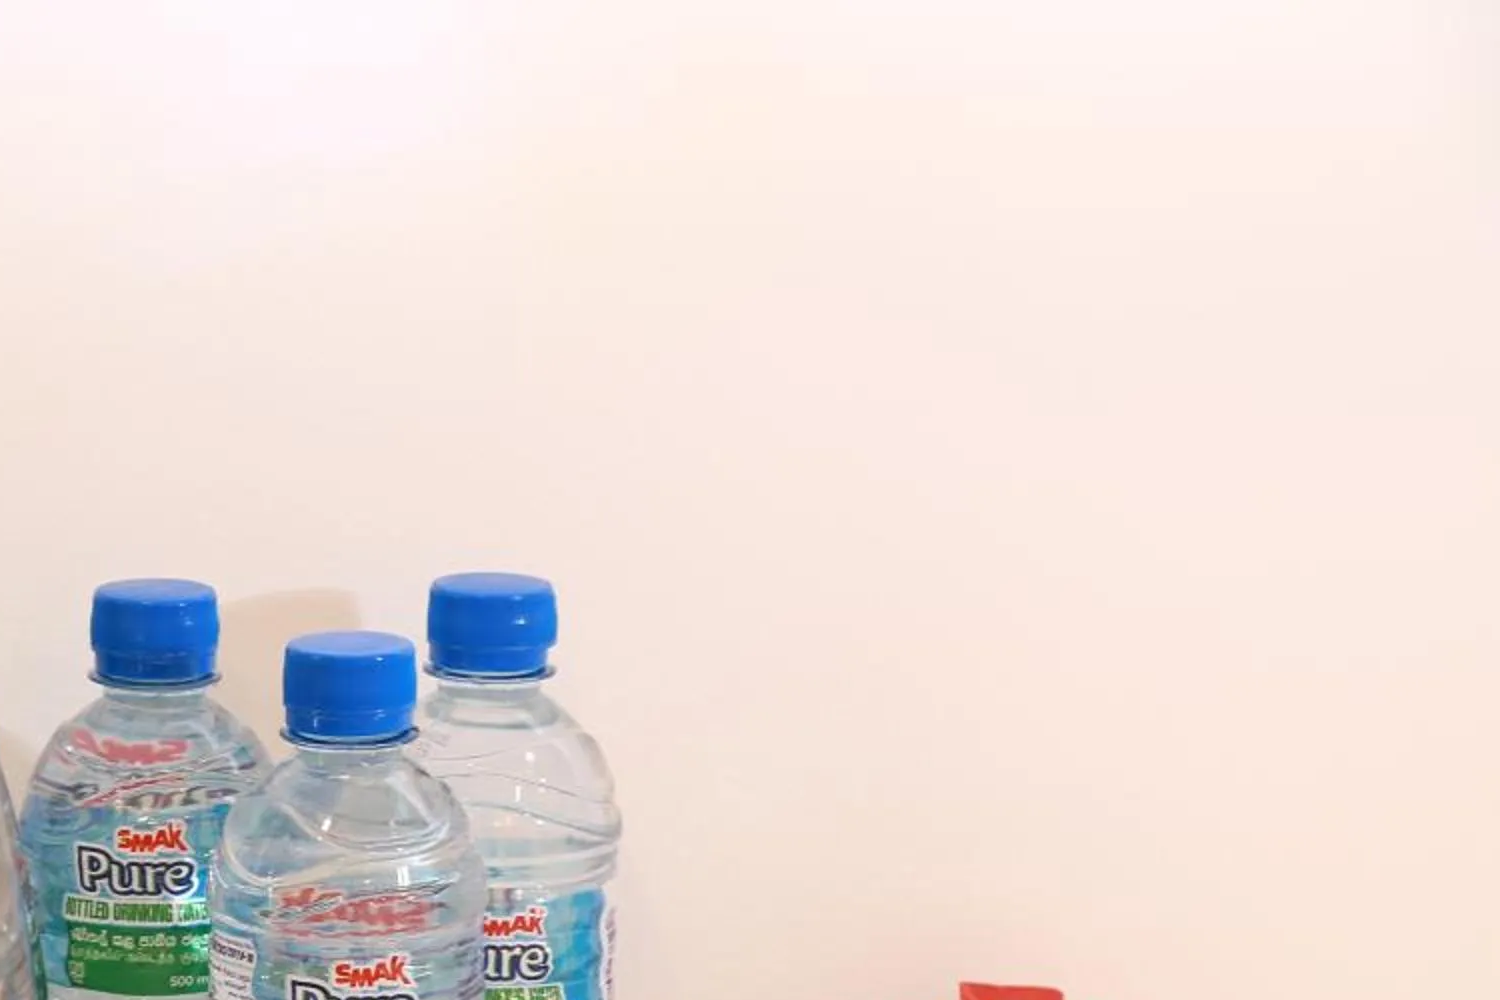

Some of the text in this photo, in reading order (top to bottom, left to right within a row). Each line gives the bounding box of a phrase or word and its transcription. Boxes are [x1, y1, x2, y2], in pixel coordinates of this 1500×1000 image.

[117, 823, 188, 852] SMAK
[77, 845, 196, 896] Pure
[483, 908, 542, 937] MAK
[169, 975, 194, 988] 500
[335, 955, 412, 987] SMAK
